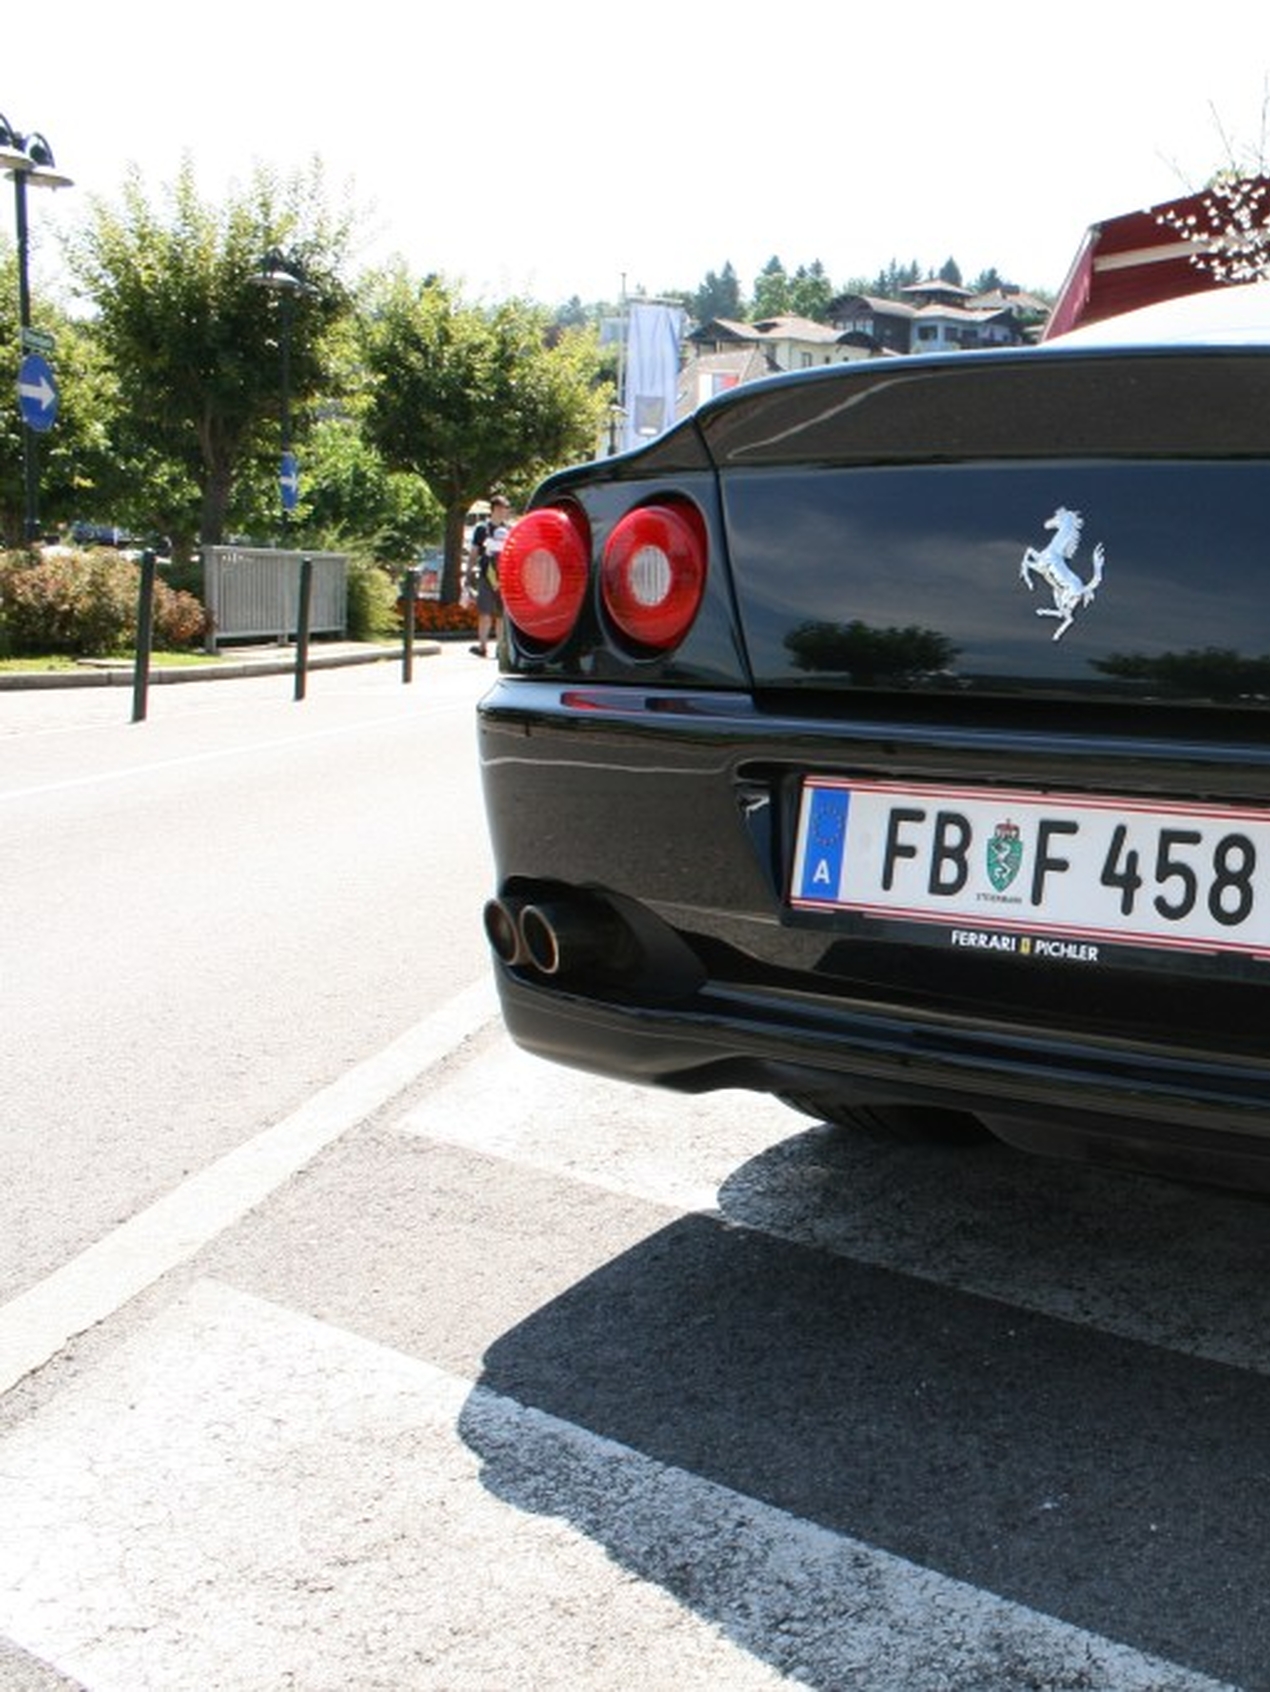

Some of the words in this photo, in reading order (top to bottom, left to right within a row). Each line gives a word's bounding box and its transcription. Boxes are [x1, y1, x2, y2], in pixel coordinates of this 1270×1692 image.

[813, 859, 831, 885] A
[882, 807, 972, 896] FB
[1031, 818, 1079, 906] F
[1100, 823, 1257, 927] 458
[951, 930, 1016, 952] FERRARI
[1035, 939, 1099, 961] PICHLER
